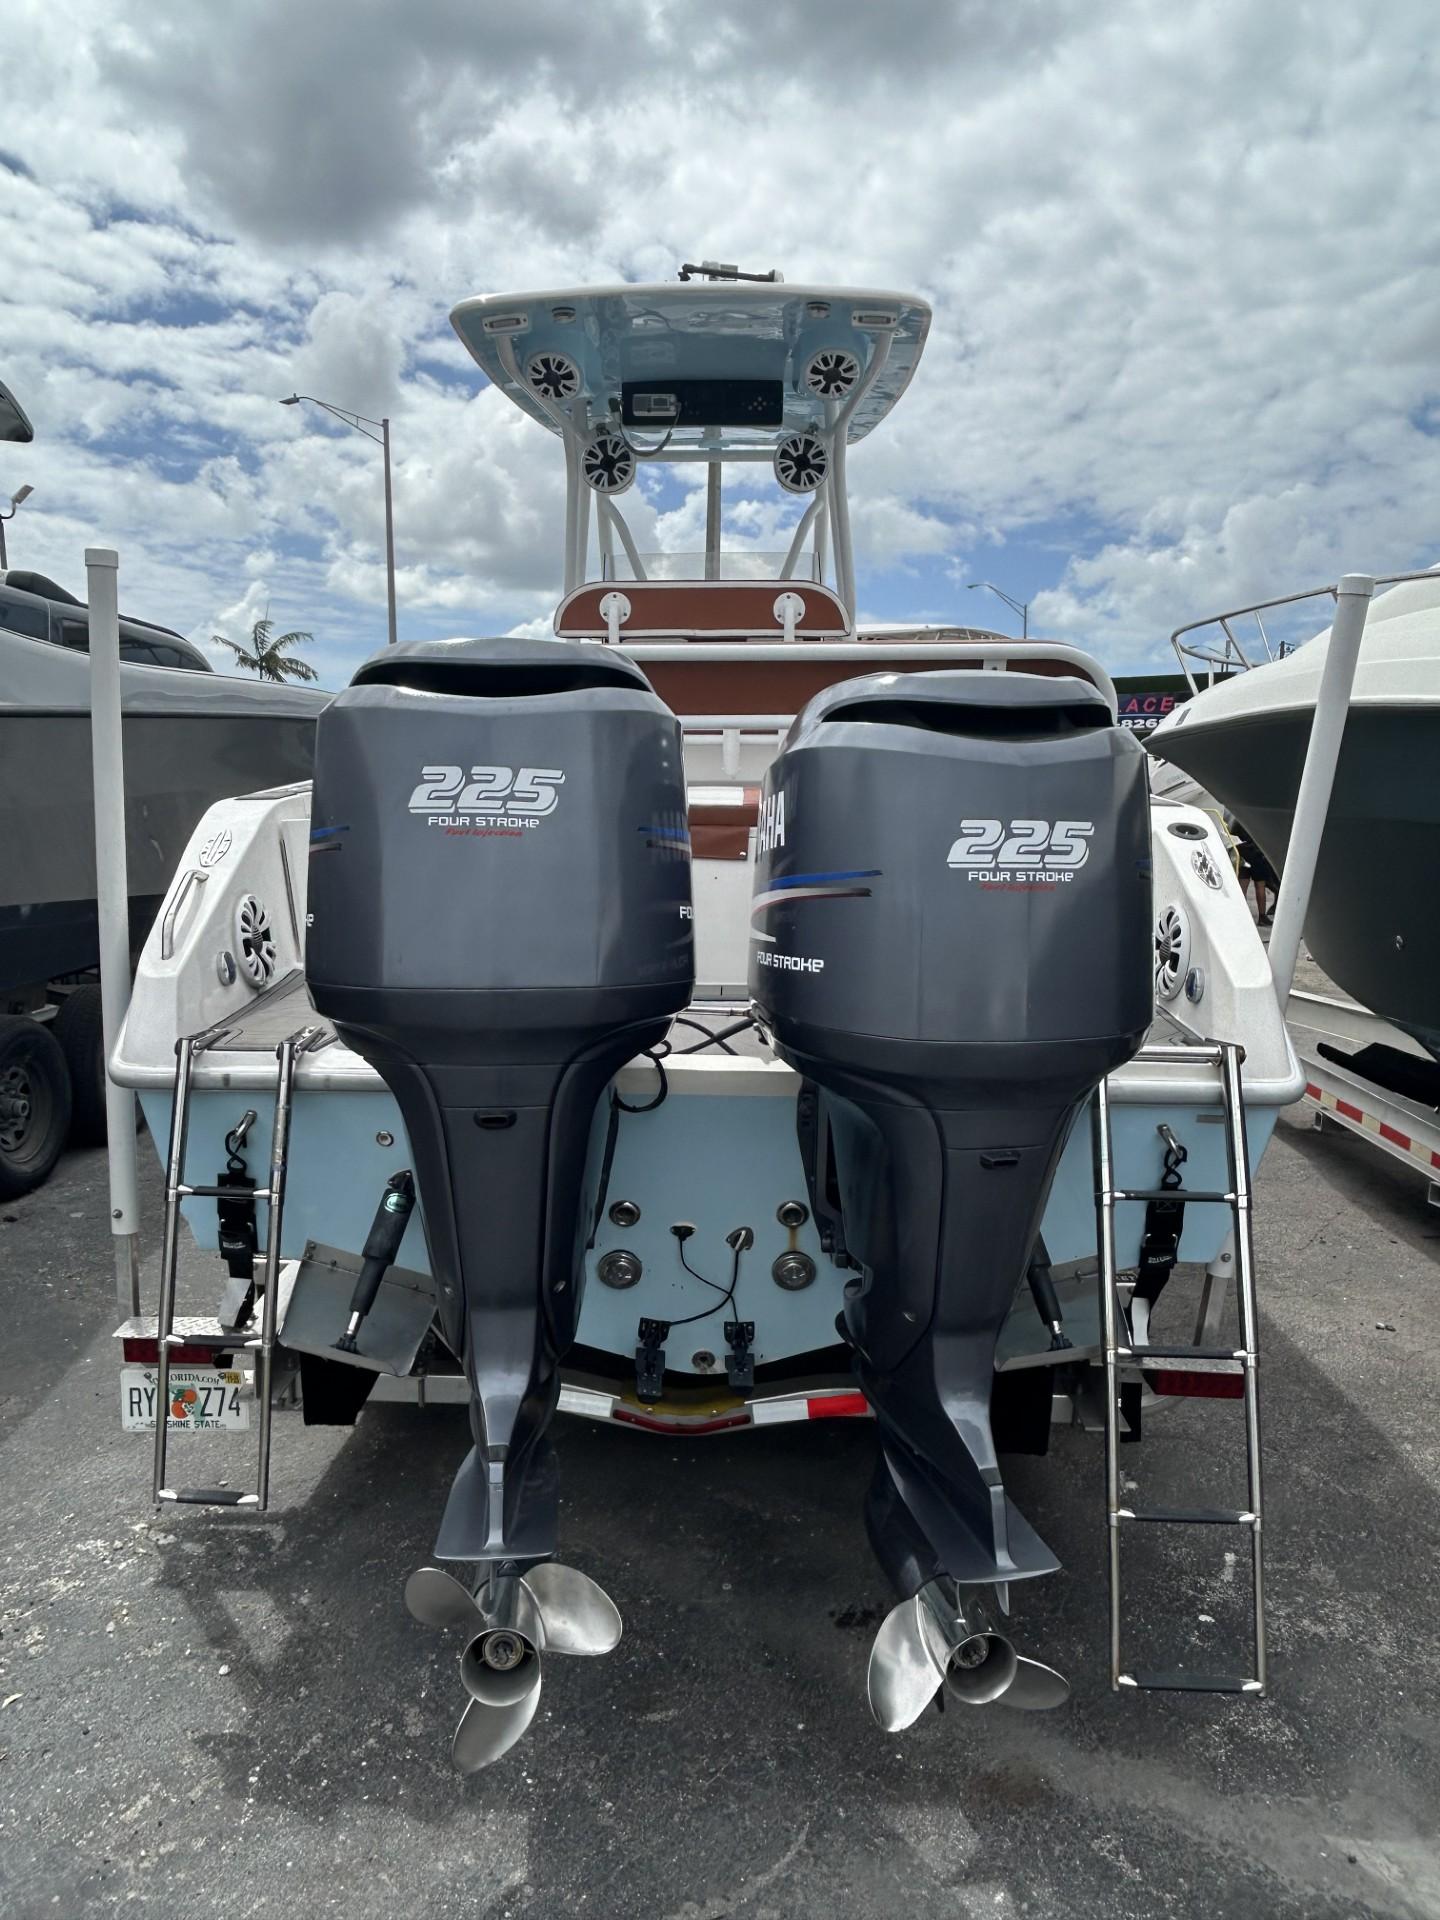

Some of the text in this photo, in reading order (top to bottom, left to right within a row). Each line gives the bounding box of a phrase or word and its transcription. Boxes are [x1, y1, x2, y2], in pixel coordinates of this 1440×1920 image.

[1119, 696, 1175, 713] ACE
[408, 766, 566, 816] 225
[428, 817, 540, 828] FOUR STROKE
[759, 790, 785, 853] AHA
[947, 819, 1095, 869] 225
[968, 871, 1074, 882] FOUR STROKE
[757, 951, 824, 972] FOUR STROKE
[129, 1387, 240, 1417] RY Z74
[151, 1420, 220, 1429] SSHINE STATE
